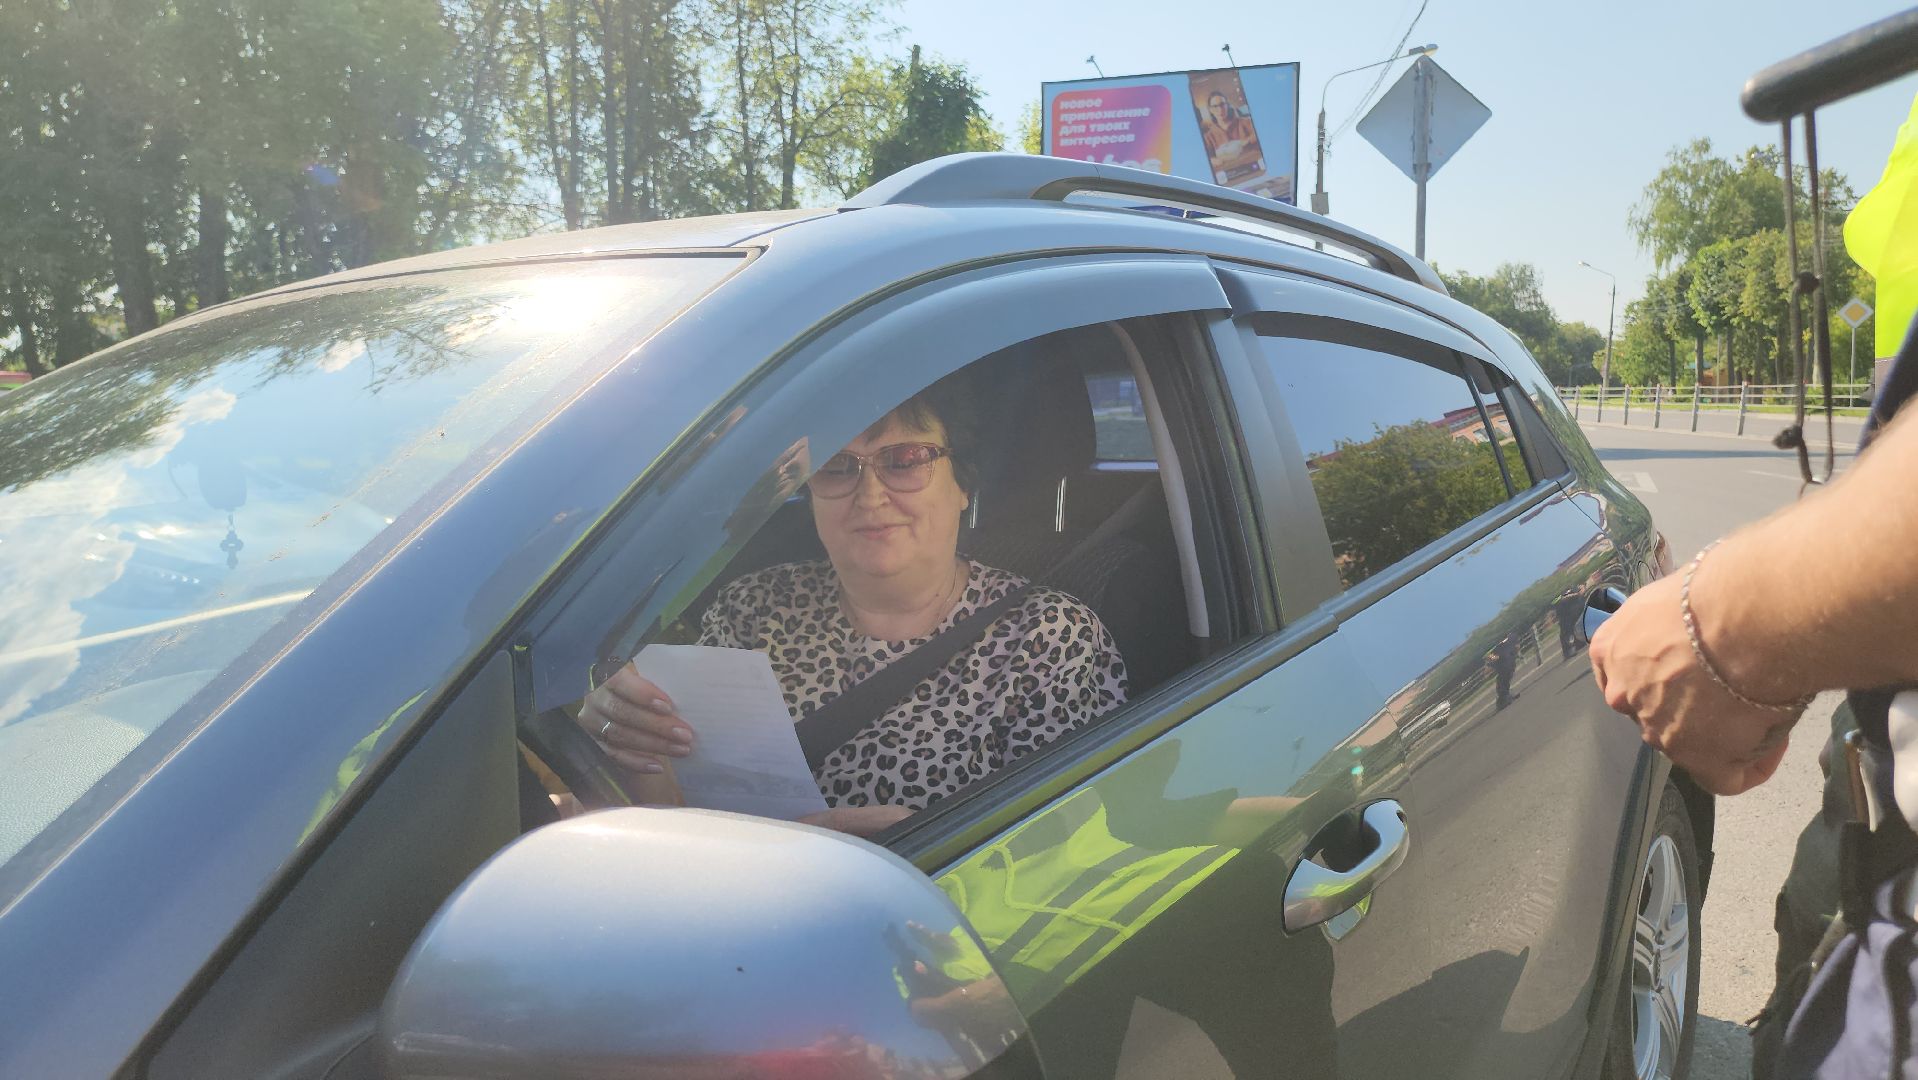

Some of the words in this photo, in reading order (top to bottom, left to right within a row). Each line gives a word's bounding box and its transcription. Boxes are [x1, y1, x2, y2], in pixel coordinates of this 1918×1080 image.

[1060, 98, 1102, 109] новое
[1060, 107, 1151, 124] приложение
[1060, 125, 1086, 136] для
[1089, 121, 1131, 132] твоих
[1060, 134, 1135, 147] интересов
